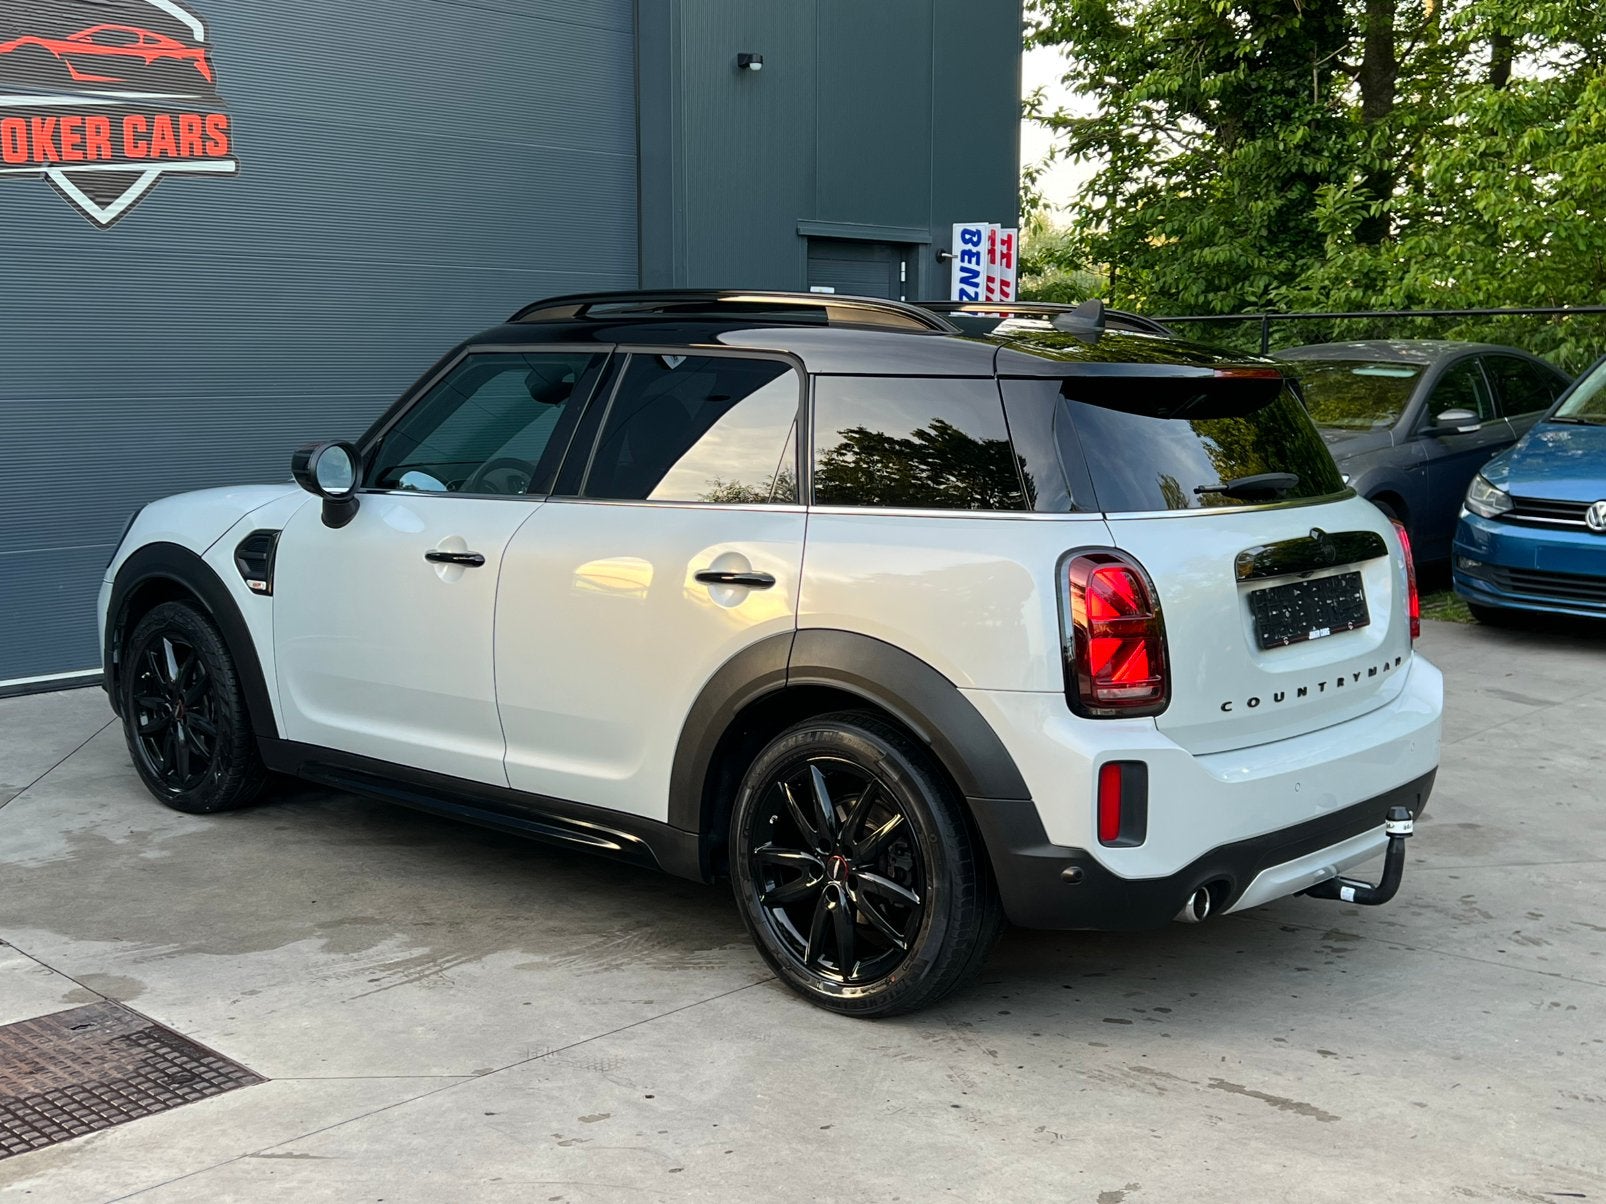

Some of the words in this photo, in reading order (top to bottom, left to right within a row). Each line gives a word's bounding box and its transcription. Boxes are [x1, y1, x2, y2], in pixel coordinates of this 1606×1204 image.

[122, 113, 229, 158] CARS
[958, 227, 982, 315] BENZ
[1220, 656, 1402, 712] COUNTRYMAN
